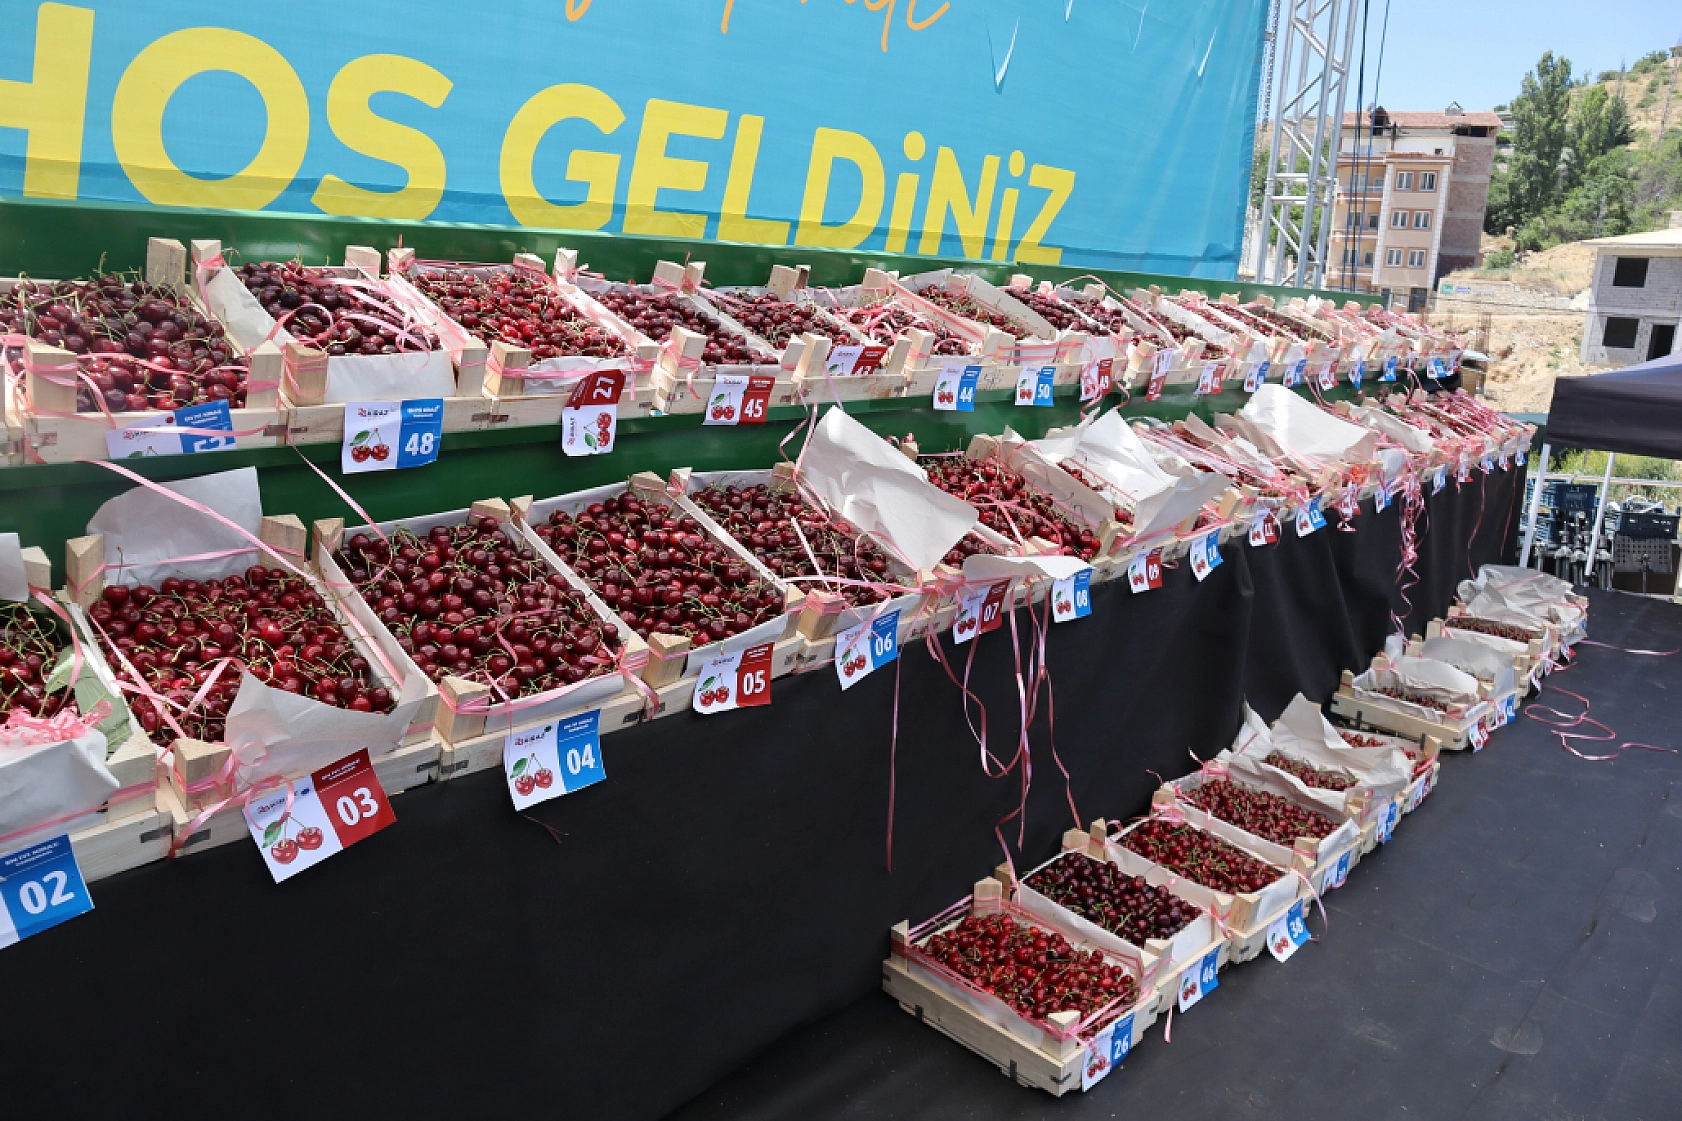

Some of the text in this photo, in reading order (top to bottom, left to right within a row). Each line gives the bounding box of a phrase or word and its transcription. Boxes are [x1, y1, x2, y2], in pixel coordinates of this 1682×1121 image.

[592, 376, 616, 400] 27
[960, 386, 974, 403] 44
[1037, 383, 1051, 400] 50
[744, 398, 764, 418] 45
[404, 432, 435, 457] 48
[983, 601, 1000, 622] 07
[875, 630, 893, 658] 06
[743, 669, 766, 696] 05
[566, 743, 599, 776] 04
[336, 787, 379, 826] 03
[19, 870, 75, 915] 02
[1114, 1034, 1129, 1060] 26
